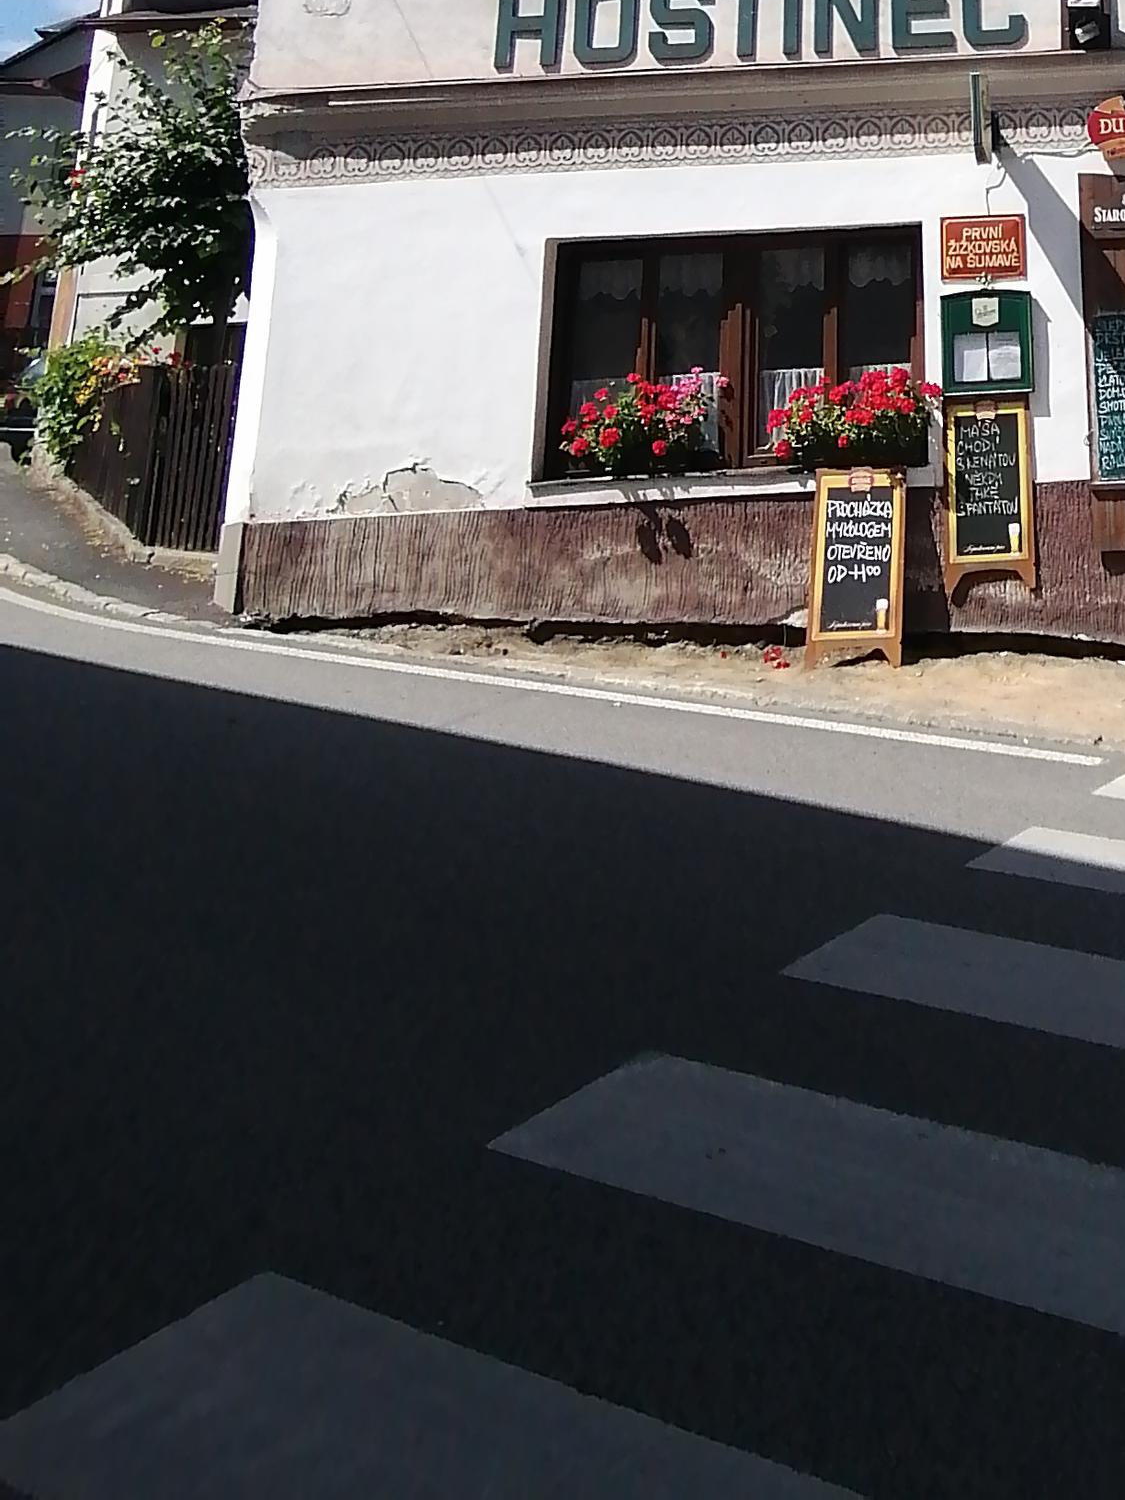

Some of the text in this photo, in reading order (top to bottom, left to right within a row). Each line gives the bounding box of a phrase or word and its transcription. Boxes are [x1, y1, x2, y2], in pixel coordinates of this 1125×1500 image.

[962, 223, 1002, 240] PRVNÍ
[948, 237, 1017, 255] ŽIŽKOVSKÁ
[946, 252, 1020, 268] NA ŠUMAVĚ
[826, 520, 891, 538] MYKOLOGEM
[827, 542, 891, 562] OTEVŘENO
[828, 566, 848, 583] OD
